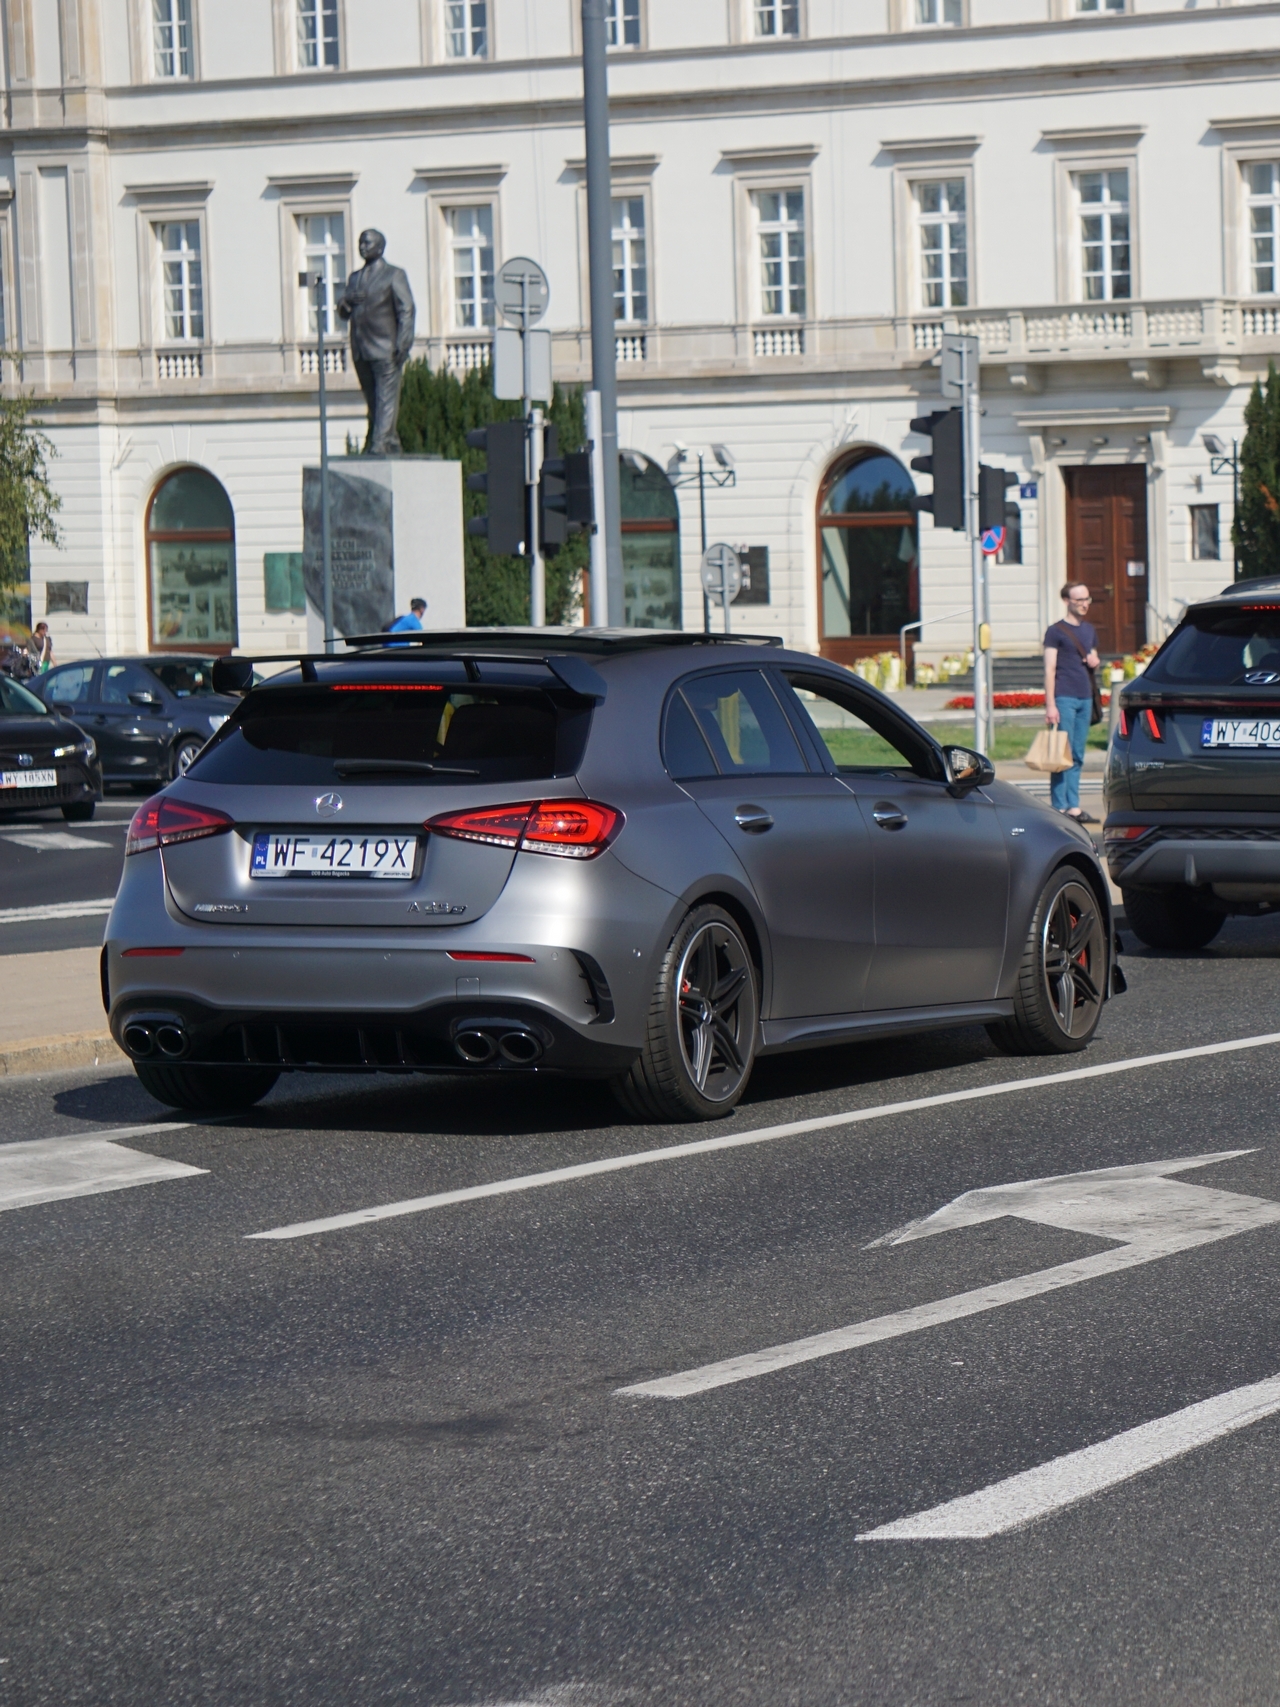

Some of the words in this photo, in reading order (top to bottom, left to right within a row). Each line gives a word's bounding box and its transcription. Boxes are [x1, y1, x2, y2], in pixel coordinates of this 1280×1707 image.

[1217, 722, 1241, 741] WY
[255, 856, 265, 865] PL
[274, 838, 310, 867] WF
[320, 838, 410, 868] 4219X
